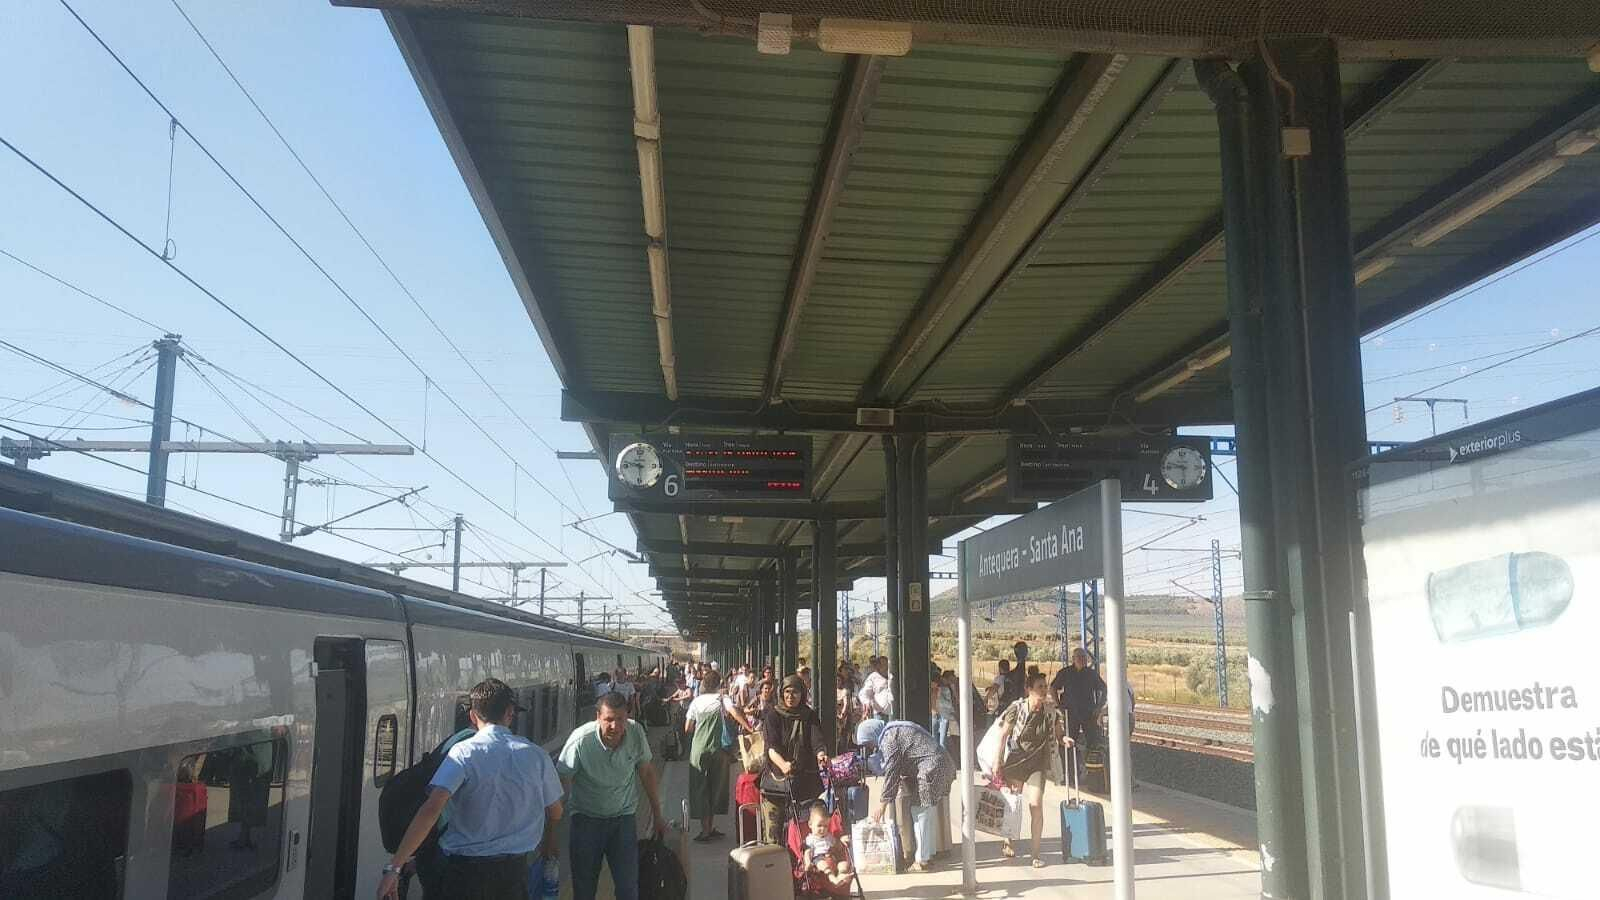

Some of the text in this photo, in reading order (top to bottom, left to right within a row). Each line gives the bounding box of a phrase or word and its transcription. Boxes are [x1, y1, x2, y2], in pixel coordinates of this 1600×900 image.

[1459, 429, 1521, 456] exteriorplus
[663, 473, 679, 496] 6
[1143, 472, 1160, 496] 4
[978, 547, 1019, 579] Antequera
[1030, 531, 1058, 564] Santa
[1061, 524, 1084, 555] Ana
[1441, 681, 1579, 714] Demuestra
[1446, 728, 1487, 765] qué
[1491, 728, 1543, 760] lado
